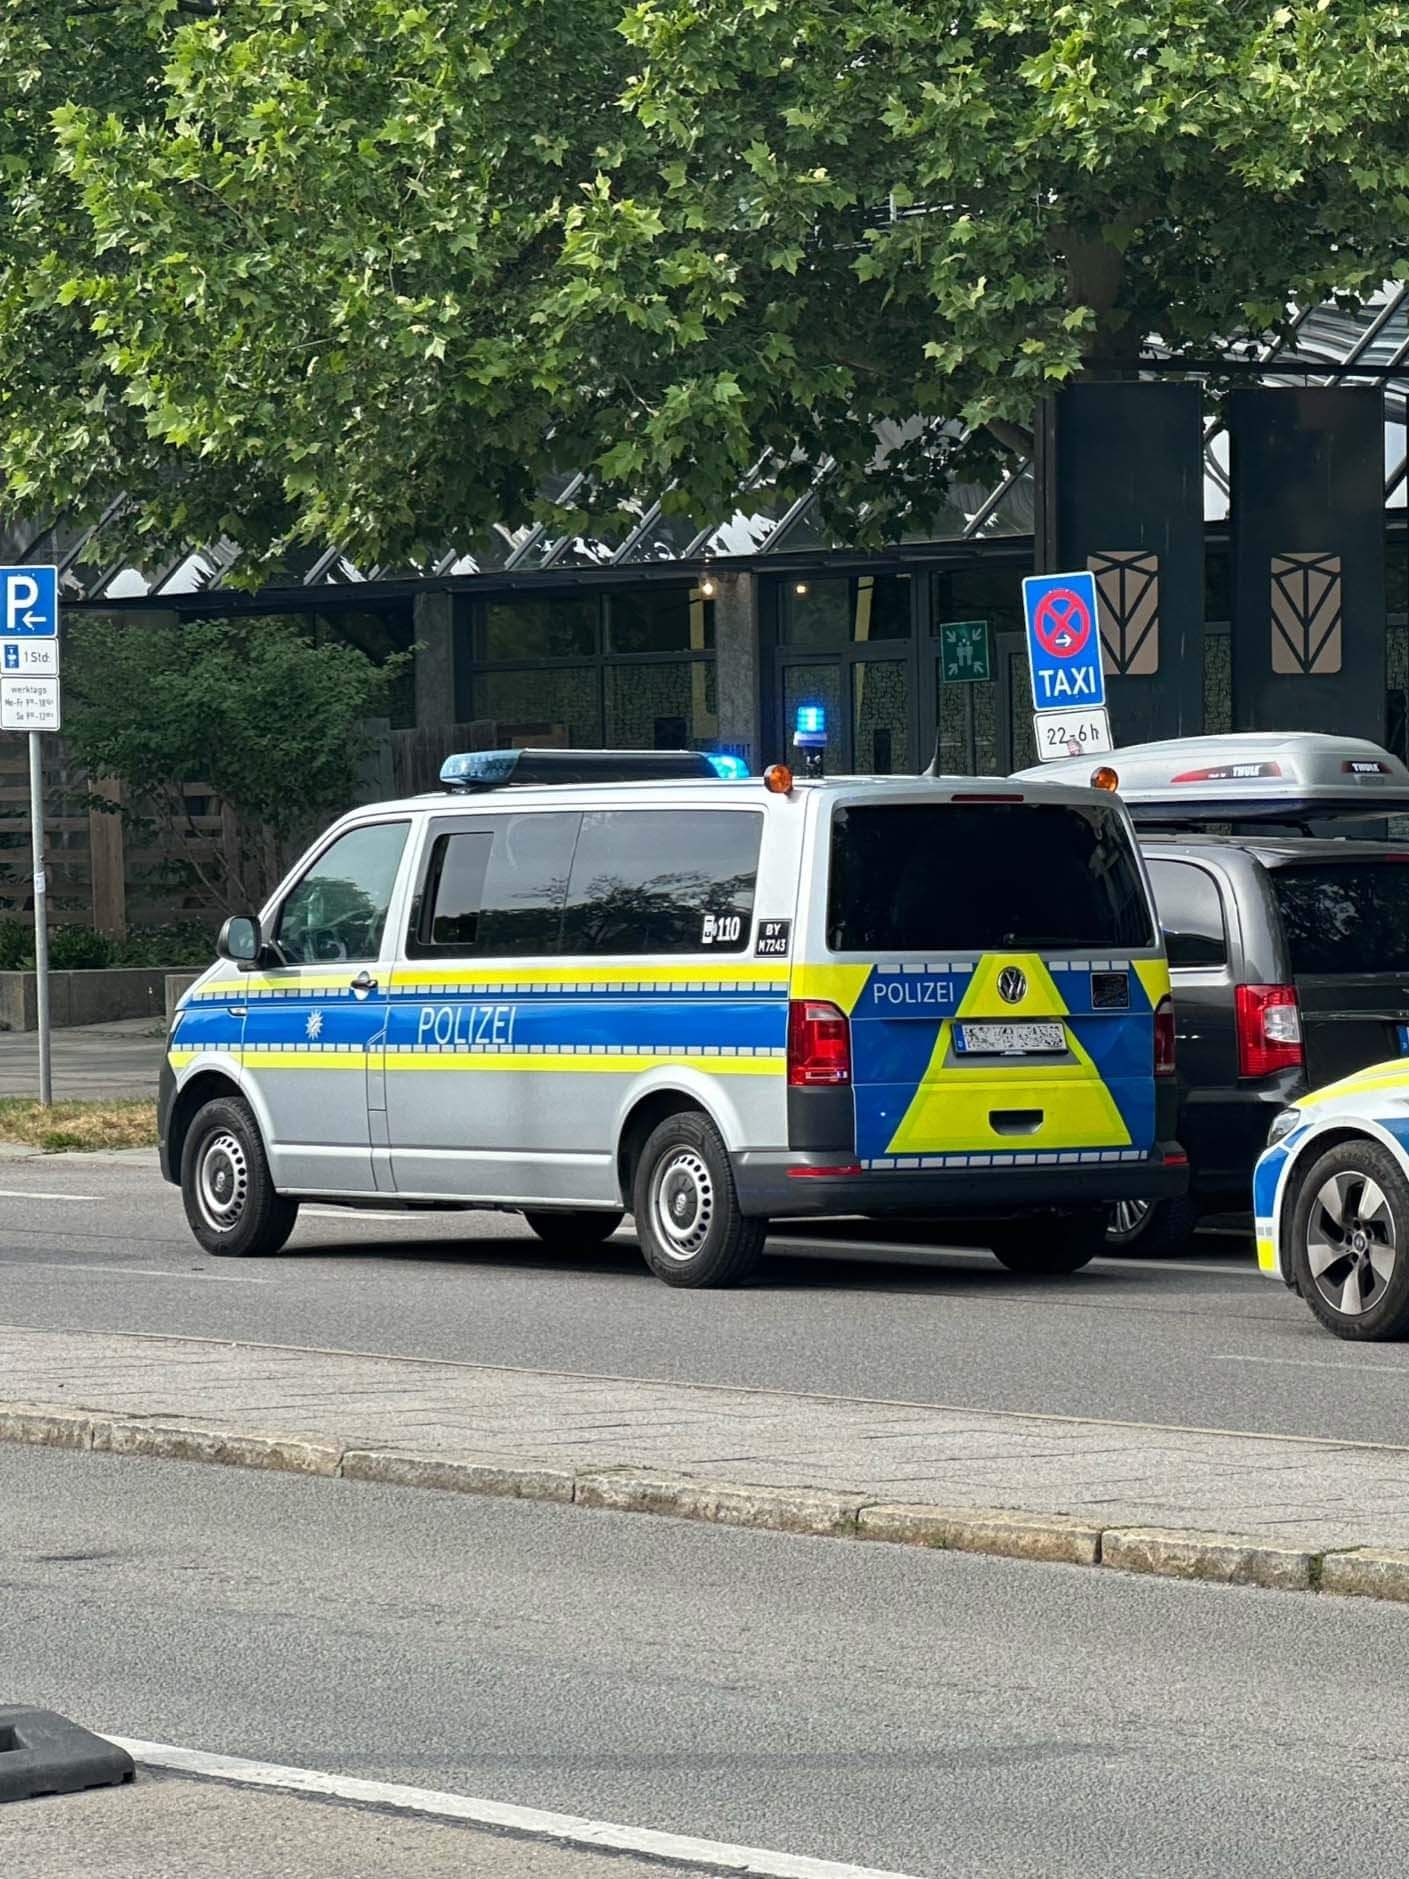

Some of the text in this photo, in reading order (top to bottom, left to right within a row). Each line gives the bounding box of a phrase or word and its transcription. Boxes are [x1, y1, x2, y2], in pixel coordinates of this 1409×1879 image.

[7, 575, 38, 629] P
[1038, 666, 1095, 697] TAXI
[1232, 764, 1263, 777] THULE
[716, 916, 741, 941] 110
[765, 923, 782, 936] BY
[766, 938, 786, 952] 7243
[873, 982, 954, 1004] POLIZEI
[418, 1006, 517, 1044] POLIZEI
